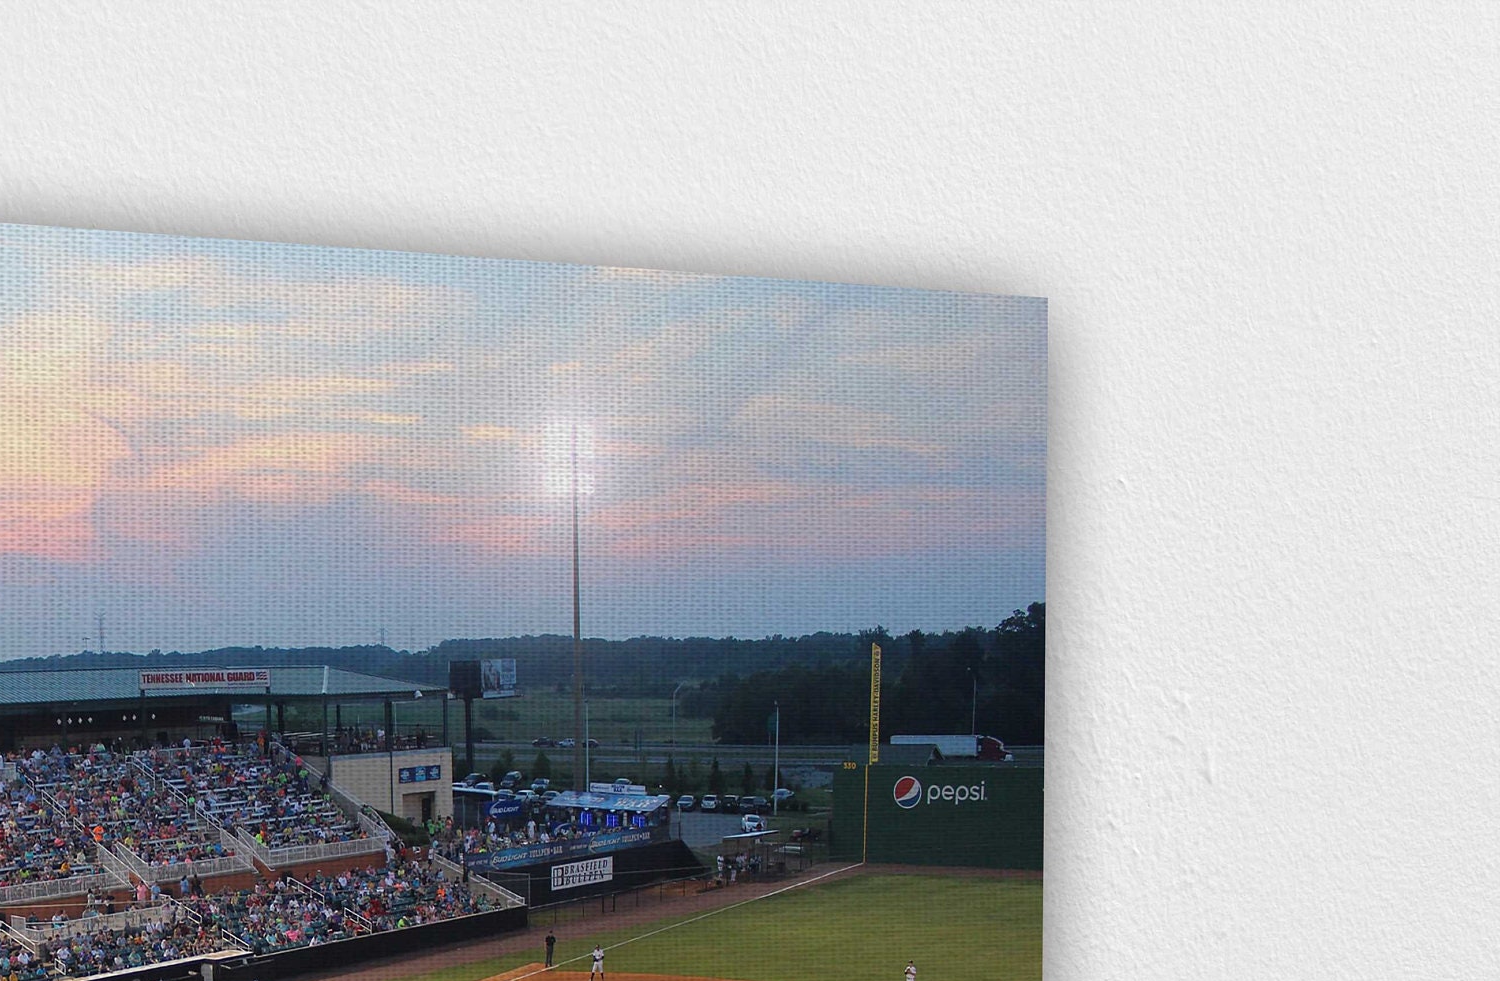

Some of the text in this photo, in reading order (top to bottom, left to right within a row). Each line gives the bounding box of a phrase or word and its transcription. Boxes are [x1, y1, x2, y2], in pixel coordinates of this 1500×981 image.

[142, 671, 255, 684] TENNESSEE NATIONAL GUARD
[843, 762, 857, 770] 330
[927, 780, 985, 805] pepsi
[564, 860, 608, 875] BRASFIELD
[565, 870, 604, 885] BULLPEN
